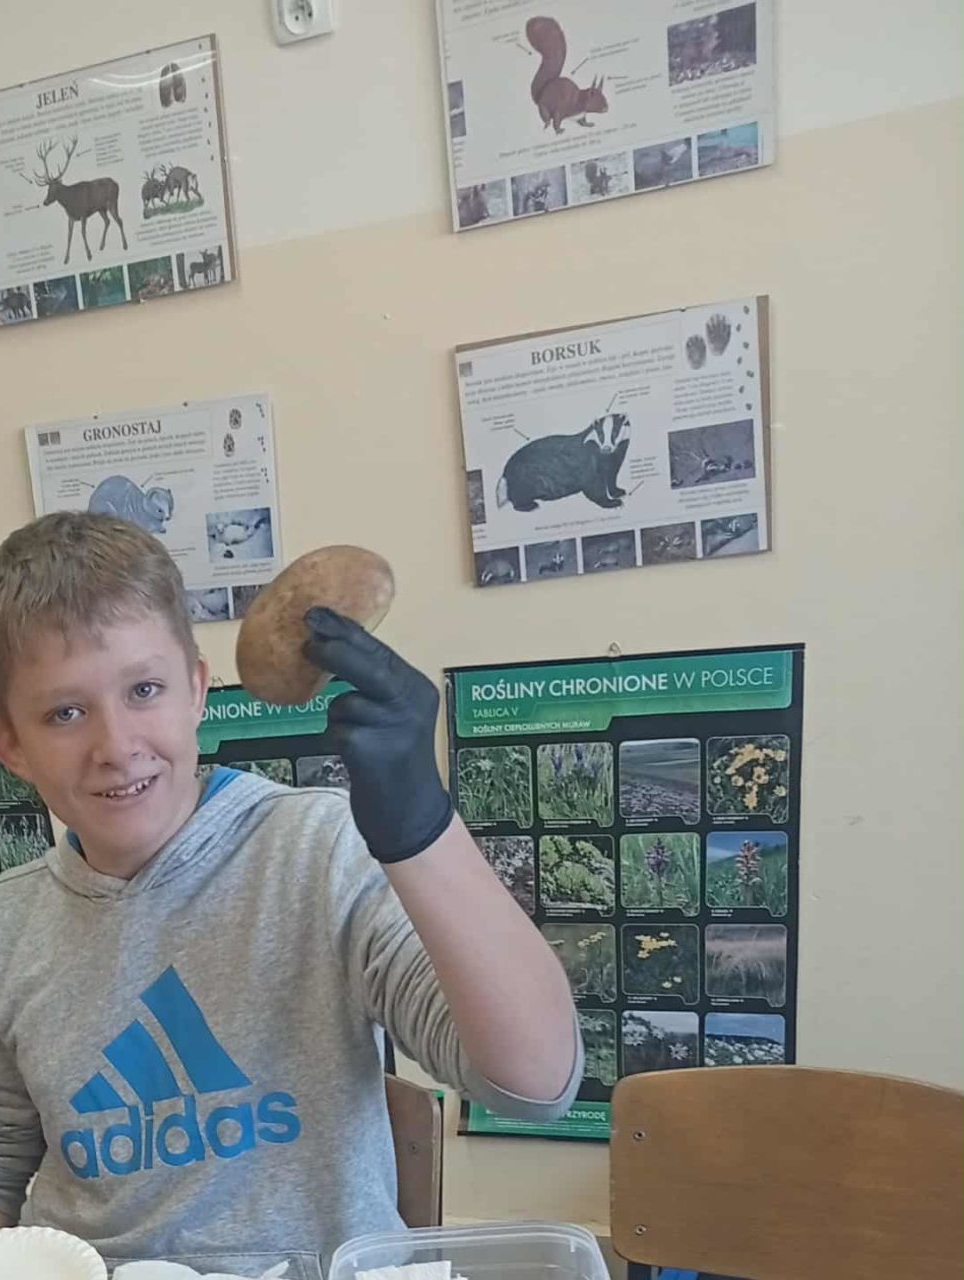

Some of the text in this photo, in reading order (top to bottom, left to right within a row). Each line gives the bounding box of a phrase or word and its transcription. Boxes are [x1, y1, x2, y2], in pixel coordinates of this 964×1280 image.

[35, 79, 80, 109] JELEŃ
[530, 339, 602, 366] BORSUK
[83, 420, 162, 442] GRONOSTAJ
[471, 667, 773, 701] ROŚLINY CHRONIONE W POLSCE
[60, 1091, 301, 1179] adidas
